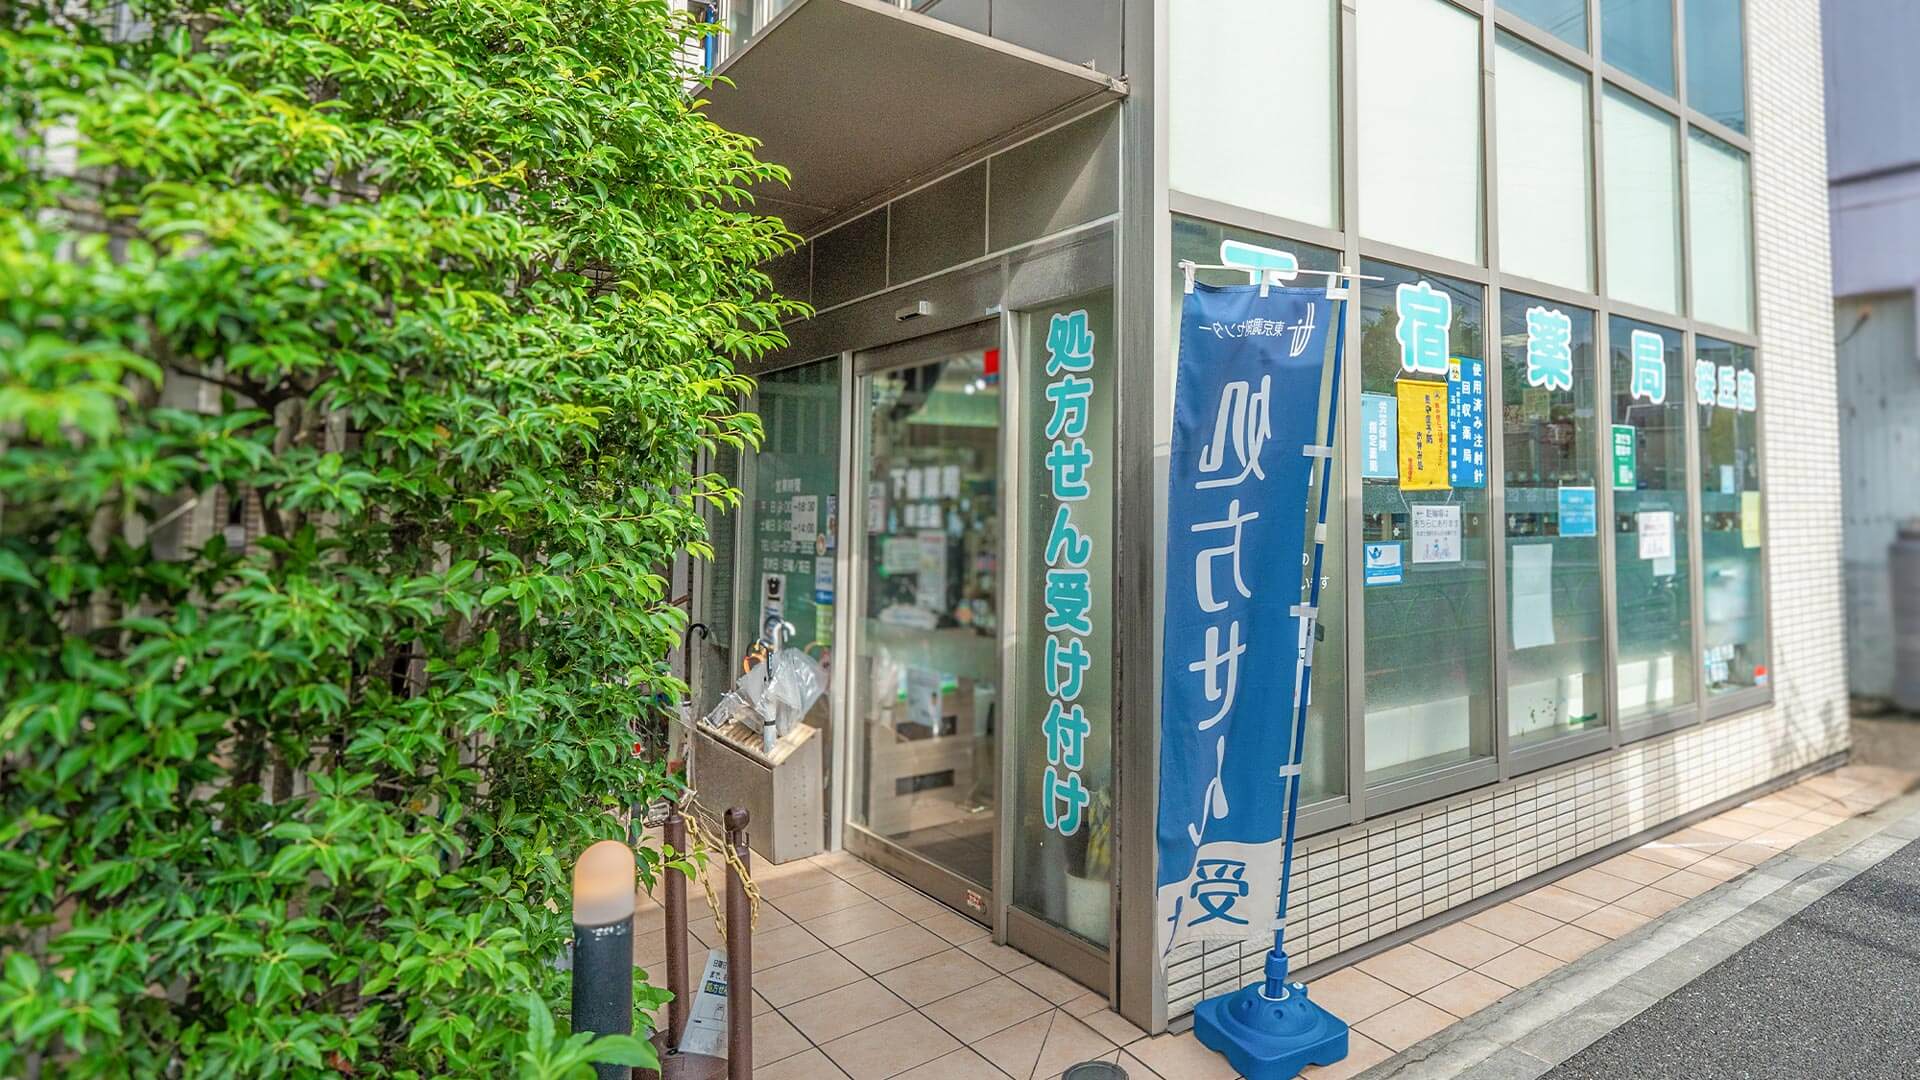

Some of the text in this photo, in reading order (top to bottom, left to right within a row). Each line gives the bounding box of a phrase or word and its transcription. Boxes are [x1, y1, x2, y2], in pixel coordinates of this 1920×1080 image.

[1461, 380, 1472, 464] 回収薬局
[1472, 362, 1484, 484] 使用済み注射針
[1043, 309, 1095, 837] 処方せん受け付け
